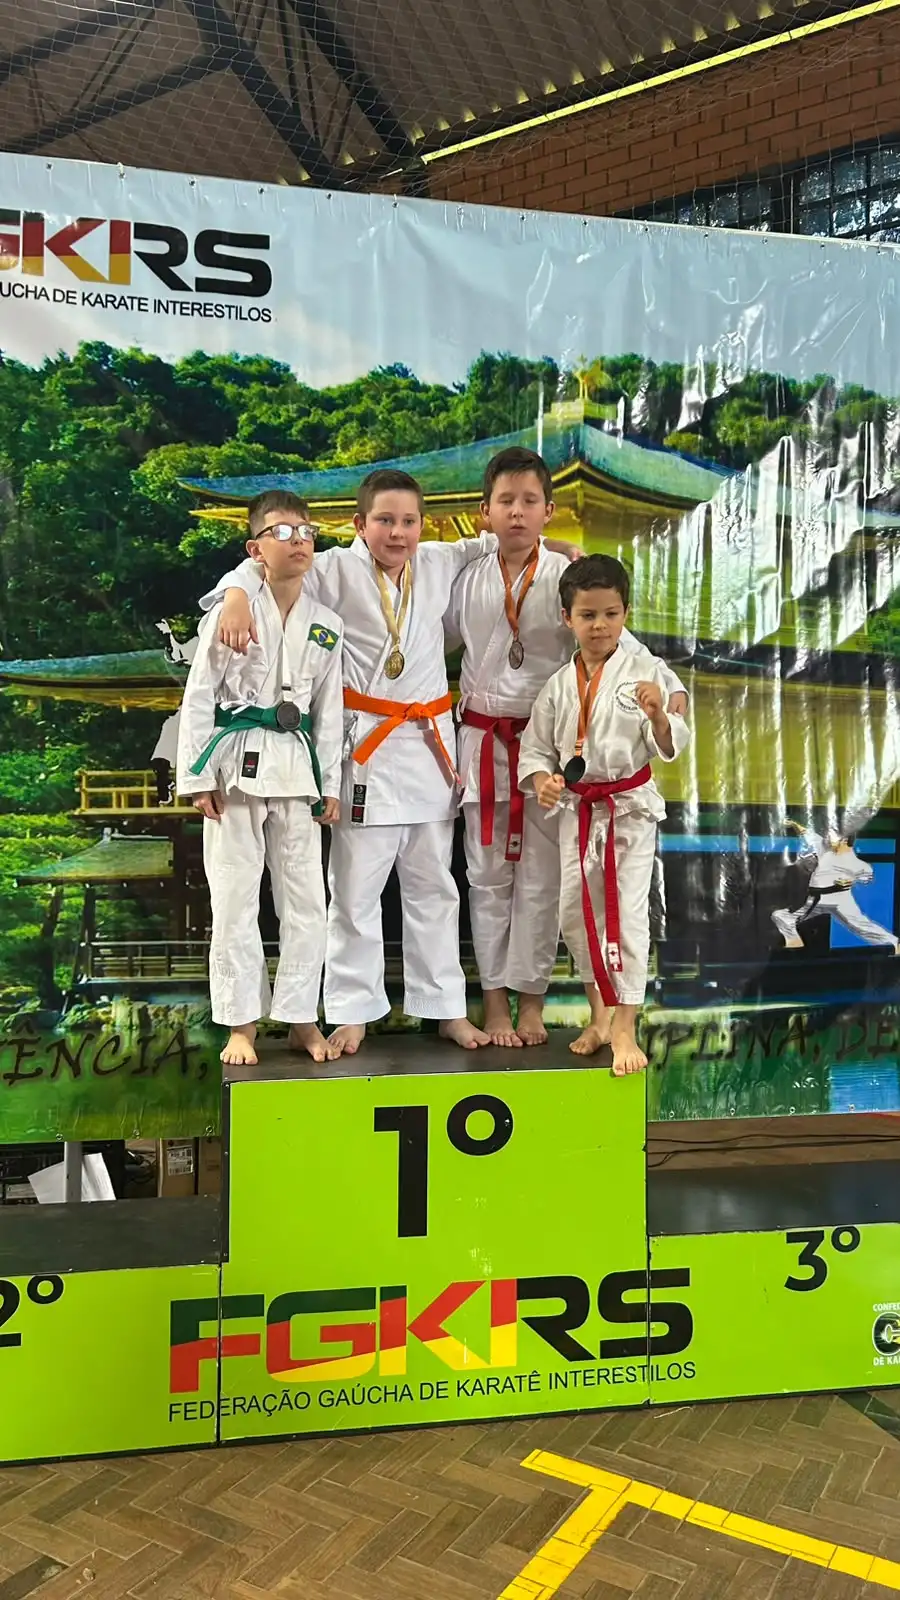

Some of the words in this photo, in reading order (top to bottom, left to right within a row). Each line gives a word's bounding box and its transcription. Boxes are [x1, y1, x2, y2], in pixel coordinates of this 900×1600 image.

[0, 208, 273, 298] KIRS
[52, 288, 77, 305] DE
[81, 292, 149, 313] KARATE
[153, 299, 272, 323] INTERESTILOS
[0, 1019, 208, 1086] ÊNCIA,
[169, 1389, 310, 1422] FEDERAÇÃO
[318, 1383, 414, 1408] GAÚCHA
[420, 1380, 449, 1400] DE
[457, 1370, 541, 1397] KARATÊ
[549, 1361, 696, 1390] INTERESTILOS
[873, 1357, 885, 1366] DE
